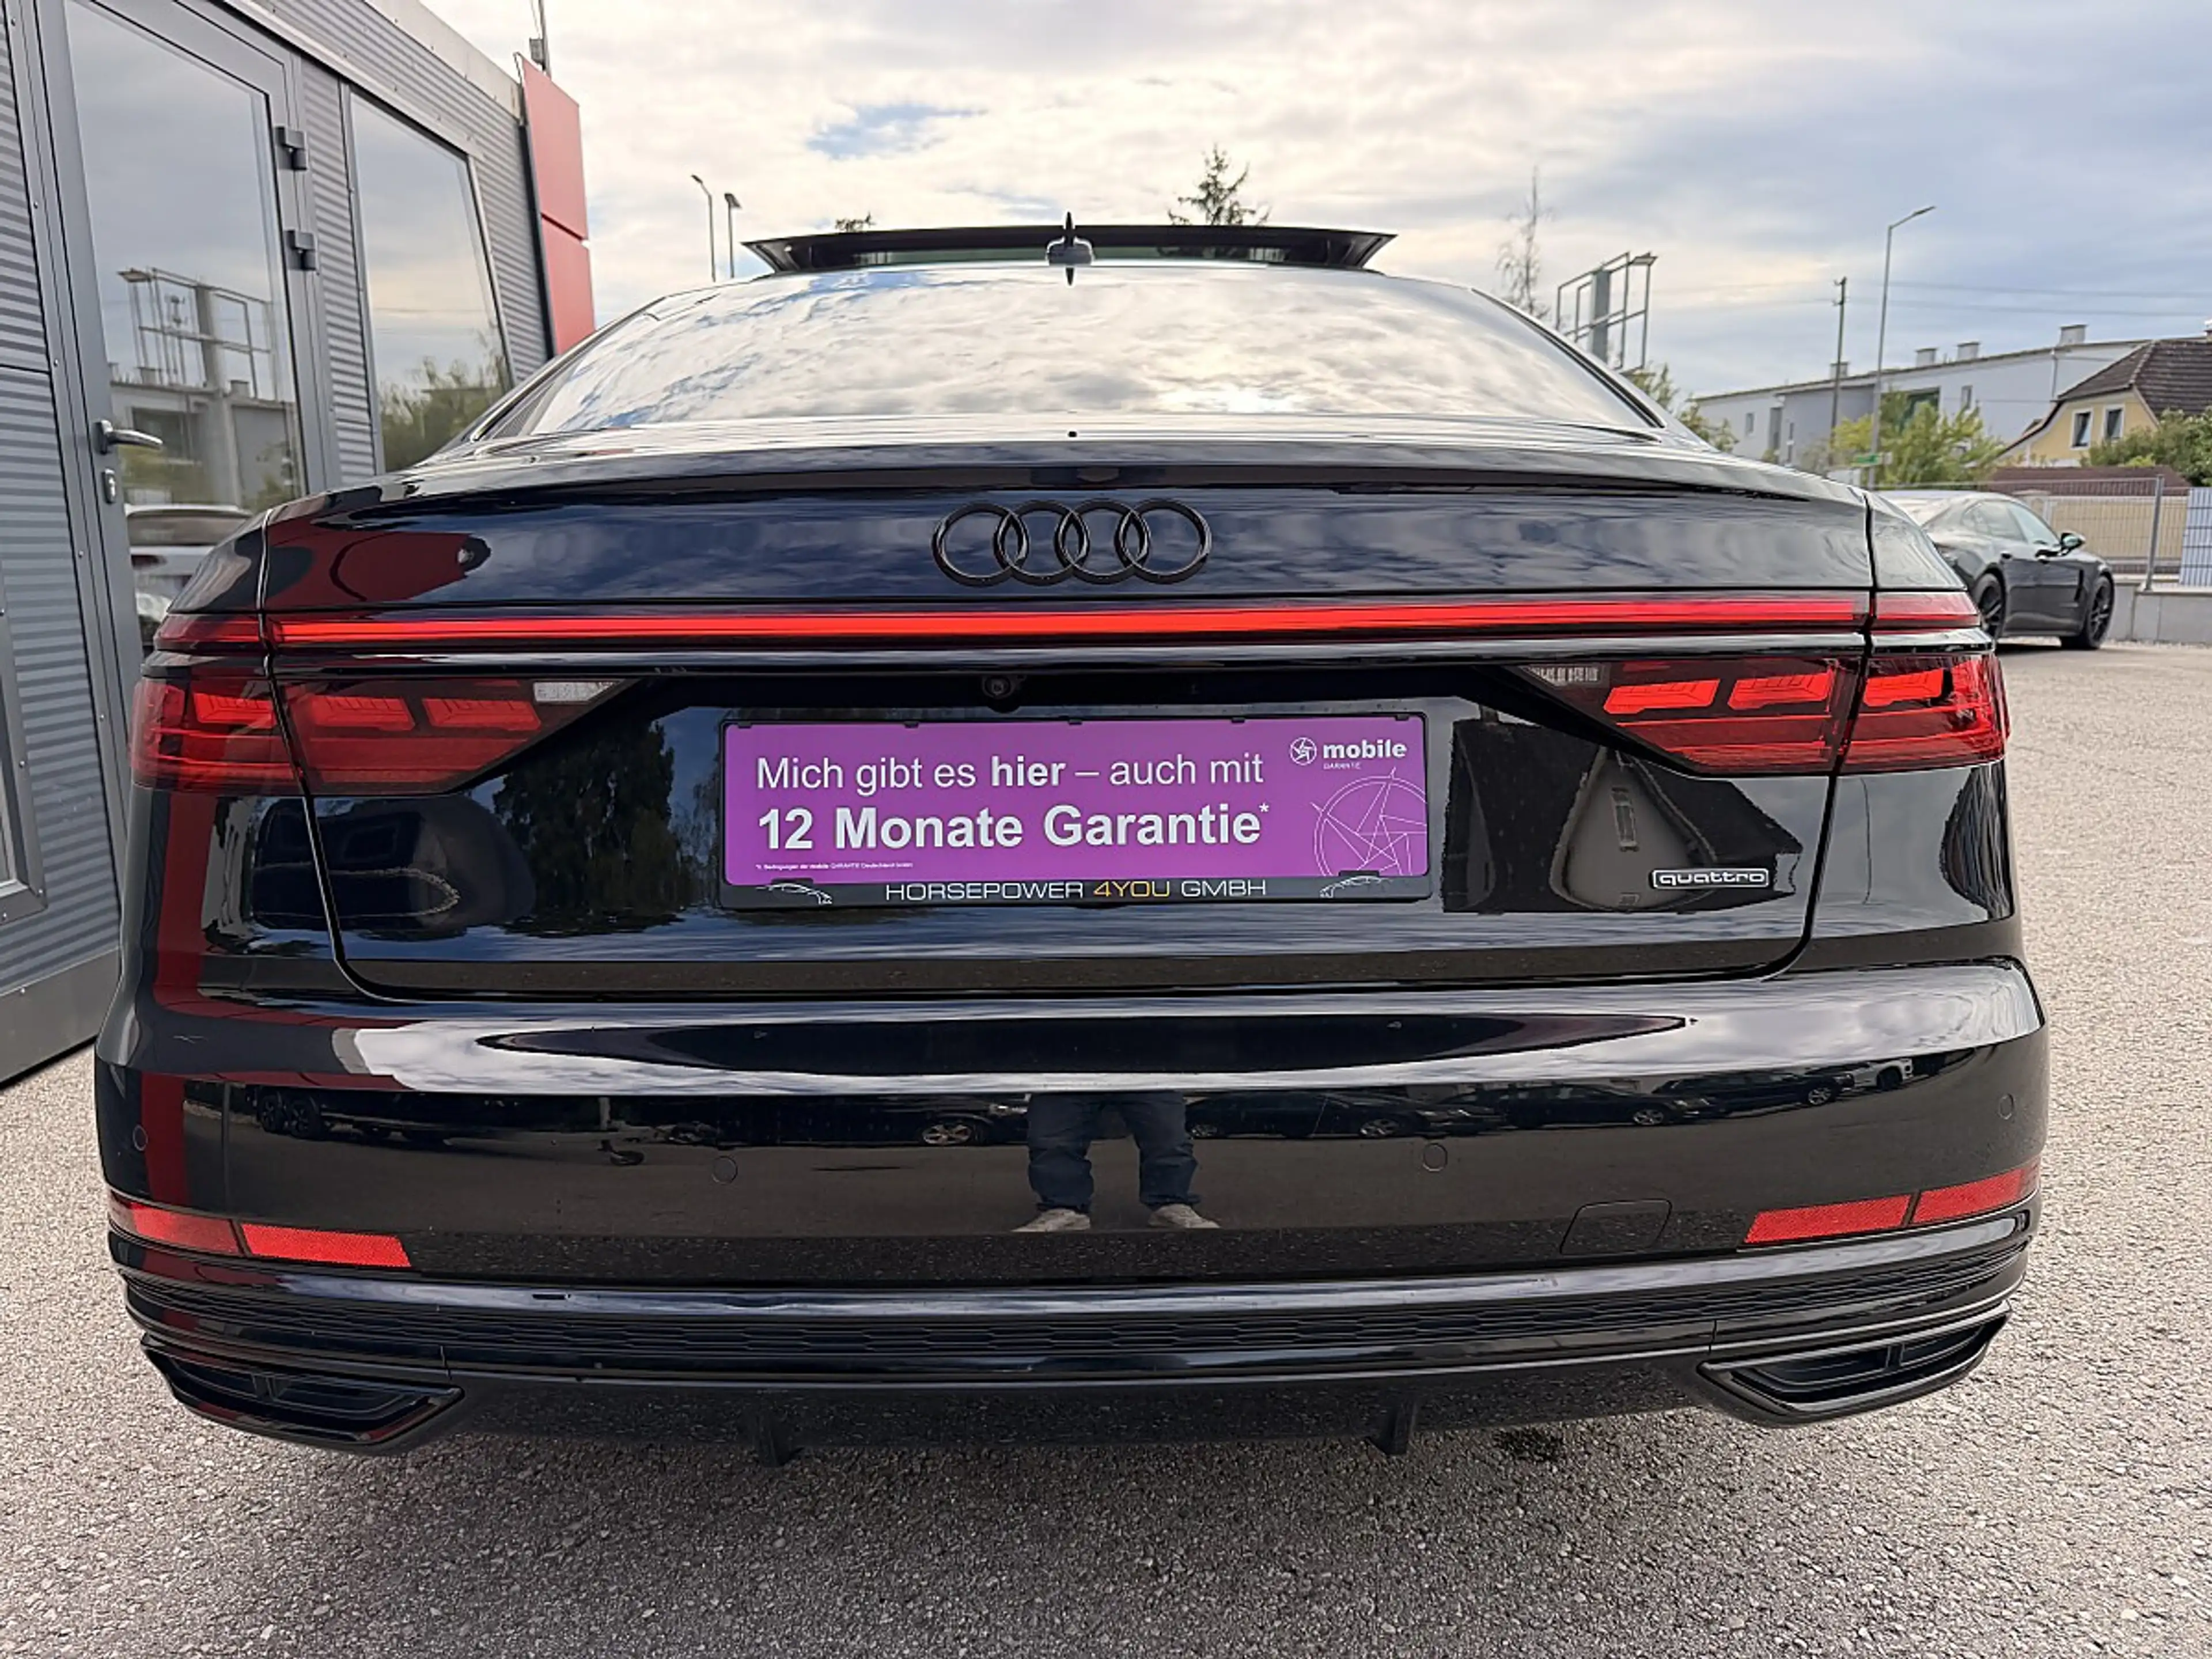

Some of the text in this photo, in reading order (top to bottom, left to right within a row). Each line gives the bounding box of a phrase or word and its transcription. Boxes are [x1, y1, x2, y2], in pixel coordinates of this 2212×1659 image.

[1323, 739, 1407, 758] mobile
[757, 757, 843, 789] Mich
[856, 756, 922, 797] gibt
[933, 763, 976, 787] es
[991, 755, 1066, 786] hier
[1109, 753, 1196, 785] auch
[1210, 752, 1264, 783] mit
[759, 807, 813, 849] 12
[836, 806, 1023, 849] Monate
[886, 879, 1266, 900] HORSEPOWER 4YOU GMBH
[1659, 872, 1765, 886] quattro
